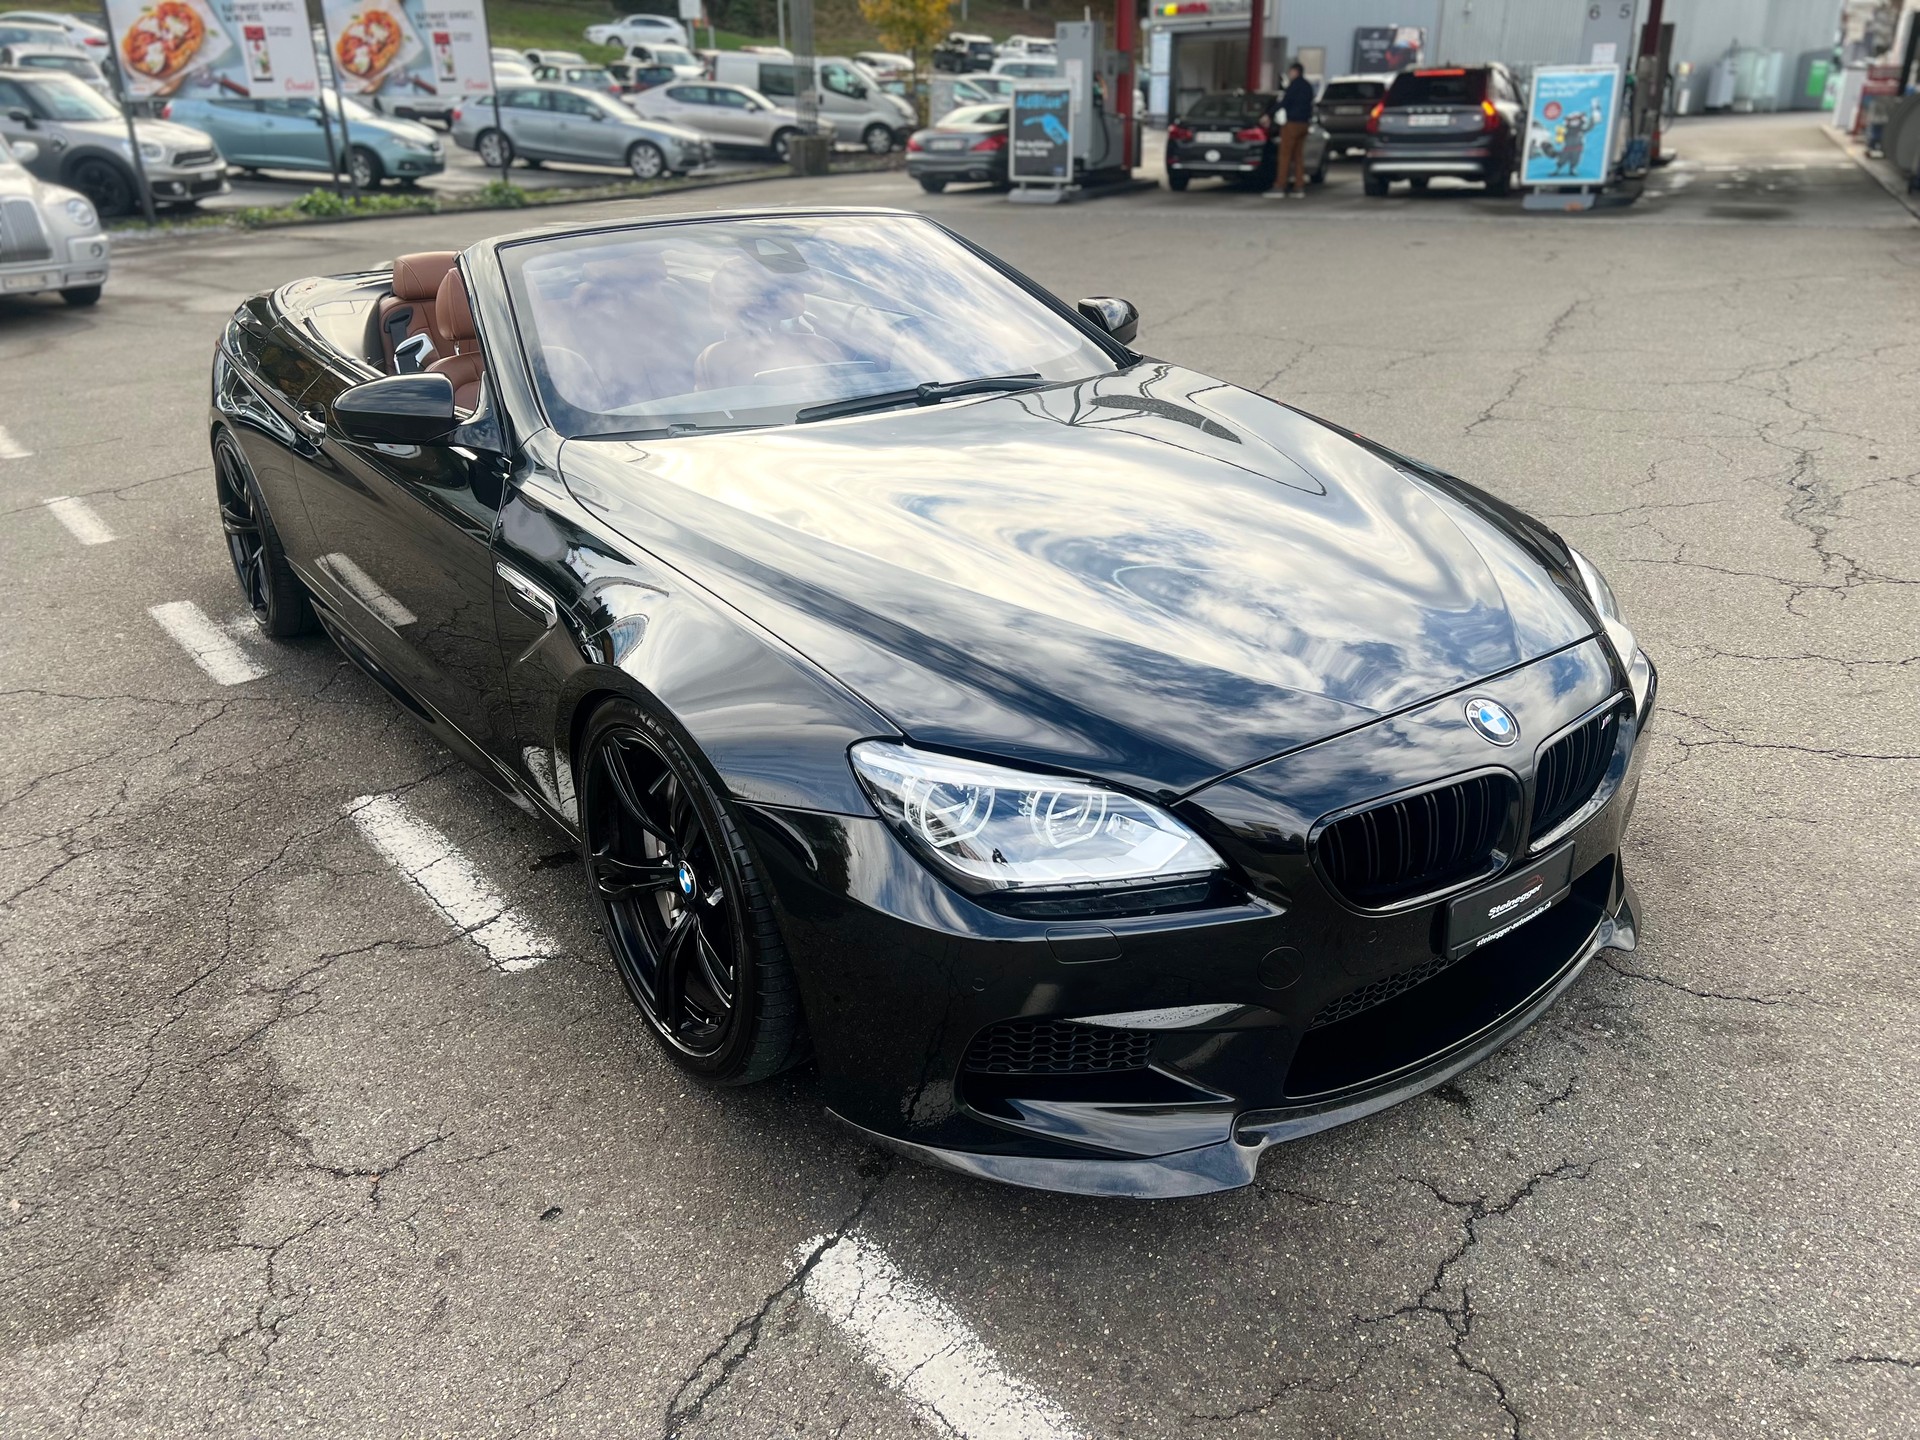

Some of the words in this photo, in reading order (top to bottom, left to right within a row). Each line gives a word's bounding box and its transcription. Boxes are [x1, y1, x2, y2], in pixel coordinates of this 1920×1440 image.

[1589, 4, 1600, 20] 6
[1619, 3, 1631, 19] 5
[1488, 883, 1543, 916] Steinegger
